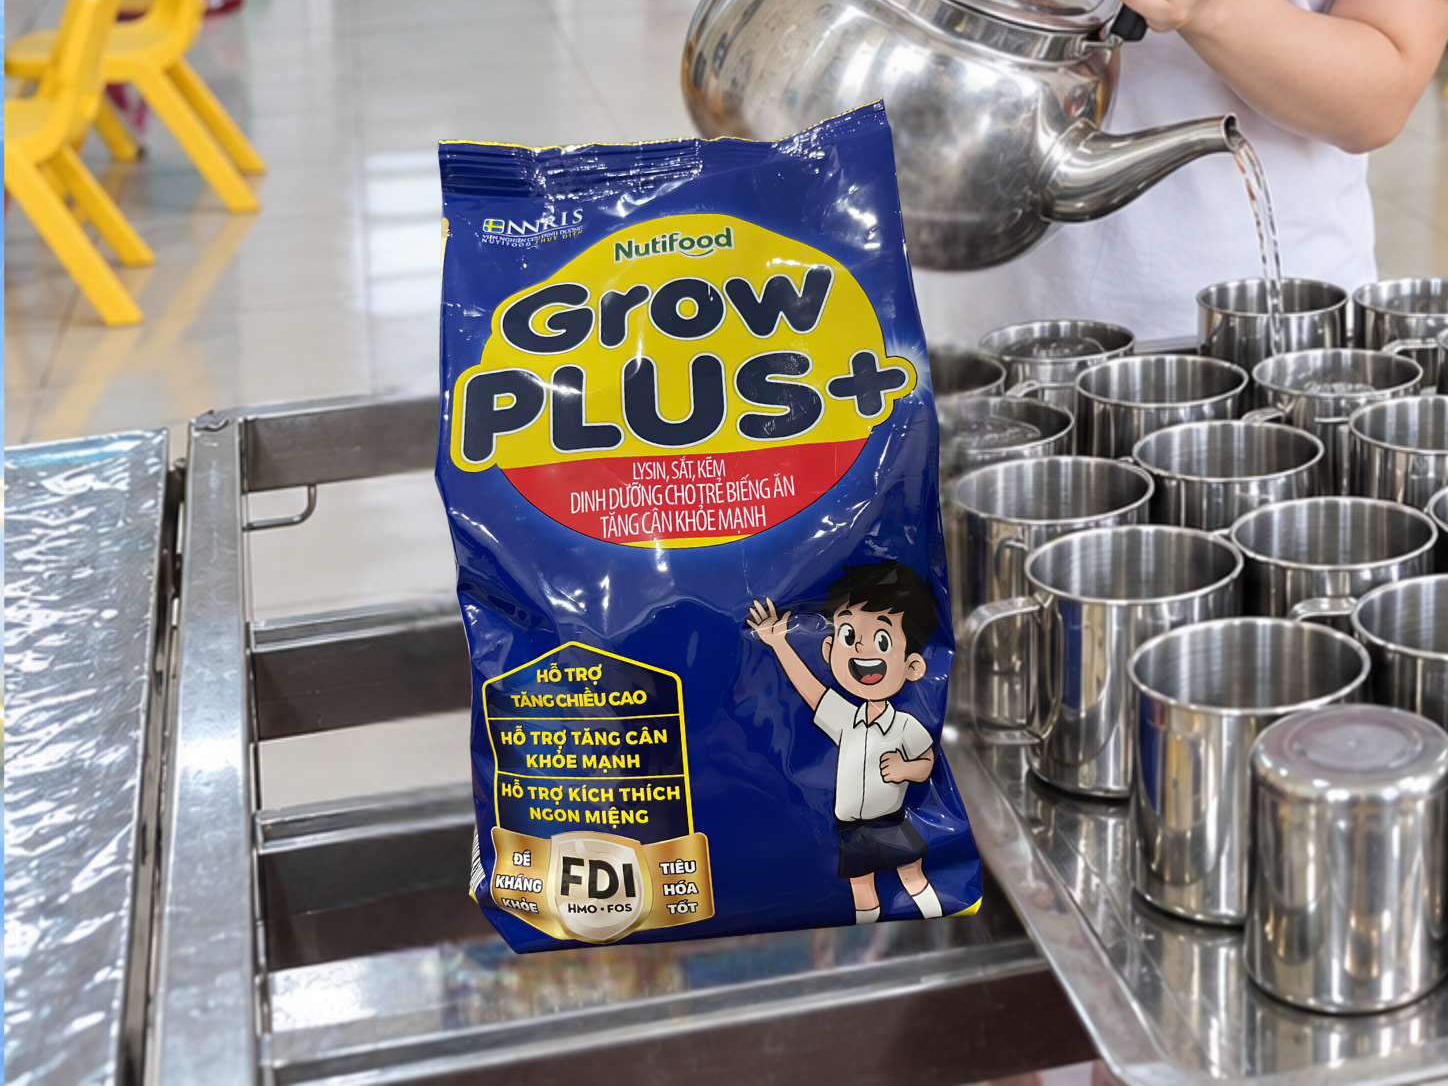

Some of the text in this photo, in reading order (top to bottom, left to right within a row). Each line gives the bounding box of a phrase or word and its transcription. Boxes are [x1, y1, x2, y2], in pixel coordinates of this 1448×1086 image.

[614, 226, 734, 262] Nutifood
[462, 350, 907, 463] PLUS+
[632, 456, 726, 482] LYSIN, SẮT, KẼM
[570, 473, 796, 514] DINH DƯỠNG CHO TRẺ BIẾNG ĂN
[600, 504, 767, 539] TĂNG CÂN KHỎE MẠNH
[536, 662, 603, 686] HỖ TRỢ
[511, 686, 648, 708] TĂNG CHIỀU CAO
[501, 725, 668, 750] HỖ TRỢ TĂNG CÂN
[526, 749, 640, 774] KHỎE MẠNH
[501, 778, 681, 806] HỖ TRỢ KÍCH THÍCH
[529, 806, 649, 829] NGON MIỆNG
[560, 856, 637, 900] FDI
[659, 858, 698, 876] TIÊU
[495, 874, 543, 893] KHÁNG
[663, 880, 699, 897] HÓA
[567, 903, 633, 914] HMO FOS
[667, 899, 698, 915] TỐT
